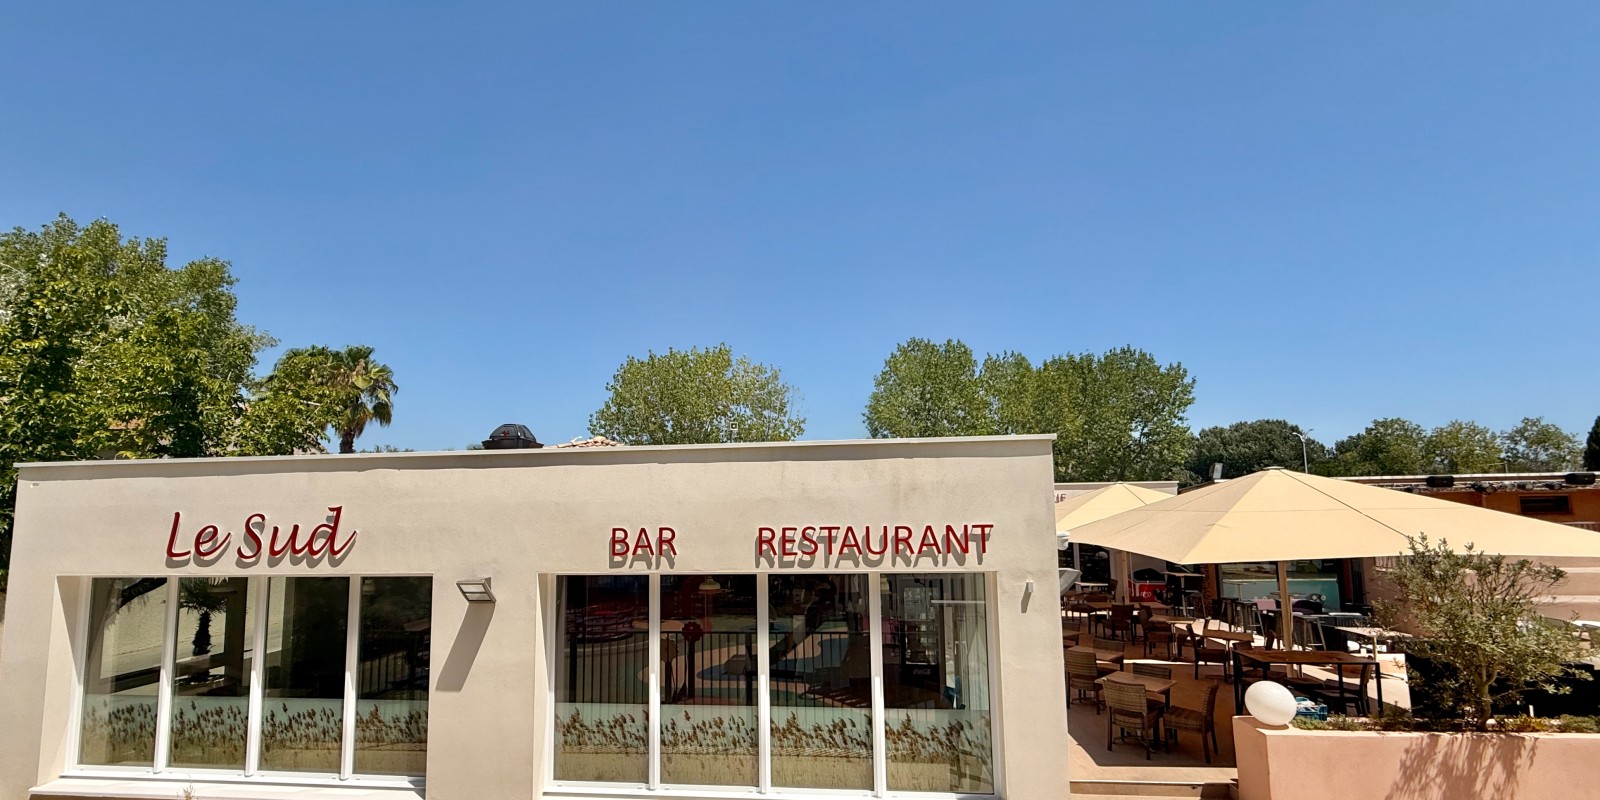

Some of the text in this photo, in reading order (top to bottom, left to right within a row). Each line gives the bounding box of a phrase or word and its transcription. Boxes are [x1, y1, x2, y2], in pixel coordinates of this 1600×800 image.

[166, 506, 358, 560] Le Sud
[611, 524, 994, 557] BAR RESTAURANT
